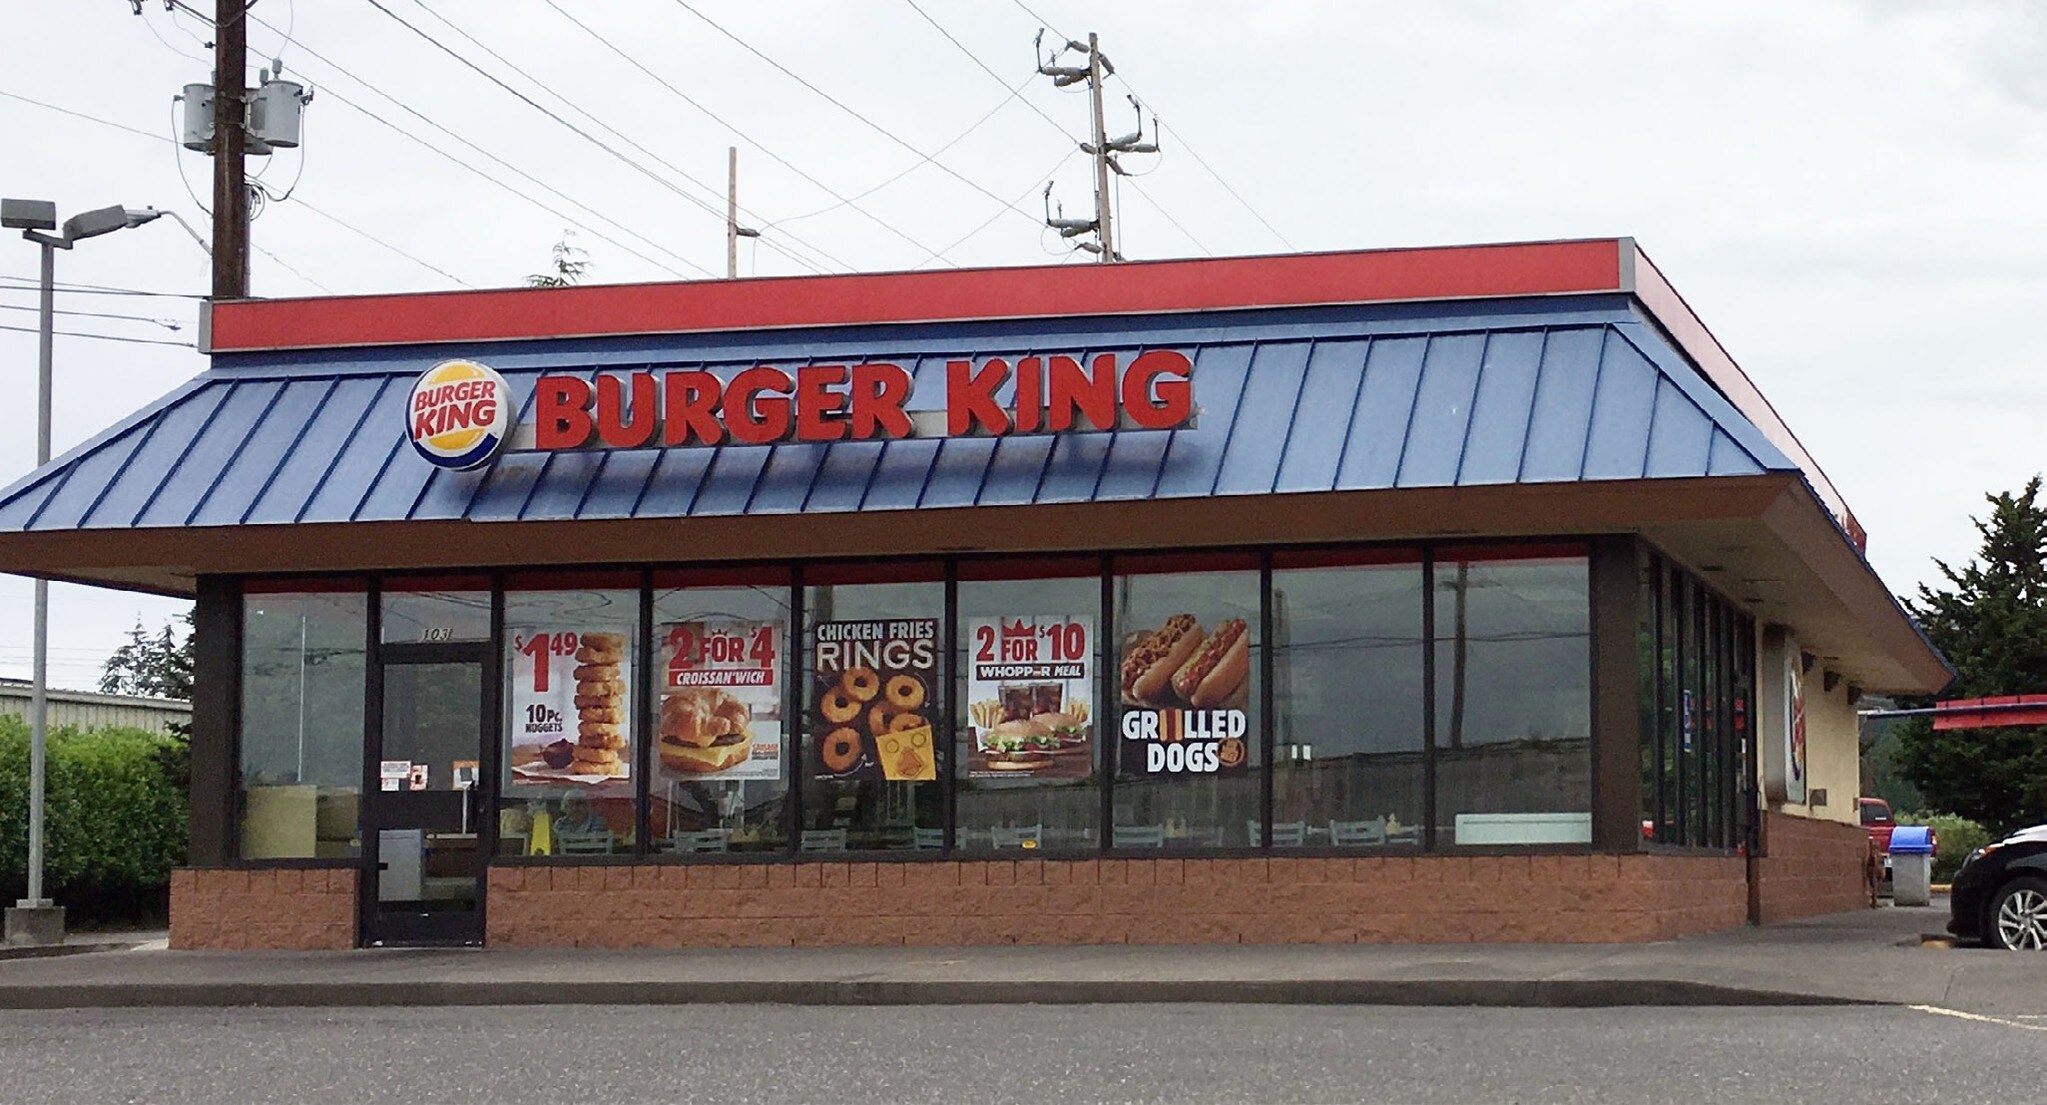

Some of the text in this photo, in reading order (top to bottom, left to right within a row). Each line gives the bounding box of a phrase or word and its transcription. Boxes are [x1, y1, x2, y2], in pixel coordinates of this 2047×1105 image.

[415, 381, 497, 413] BURGER
[536, 350, 1193, 450] BURGER KING
[415, 400, 497, 440] KING
[423, 628, 454, 641] 1031
[817, 621, 934, 641] CHICKEN FRIES
[976, 622, 1085, 661] 2 FOR $10
[668, 626, 776, 669] 2 FOR $4
[816, 638, 934, 672] RINGS
[676, 670, 766, 685] CROISSAN'WICH
[1053, 664, 1082, 677] MEAL
[525, 723, 563, 733] NUGGETS
[1122, 709, 1247, 741] GRILLED
[1147, 742, 1220, 773] DOGS
